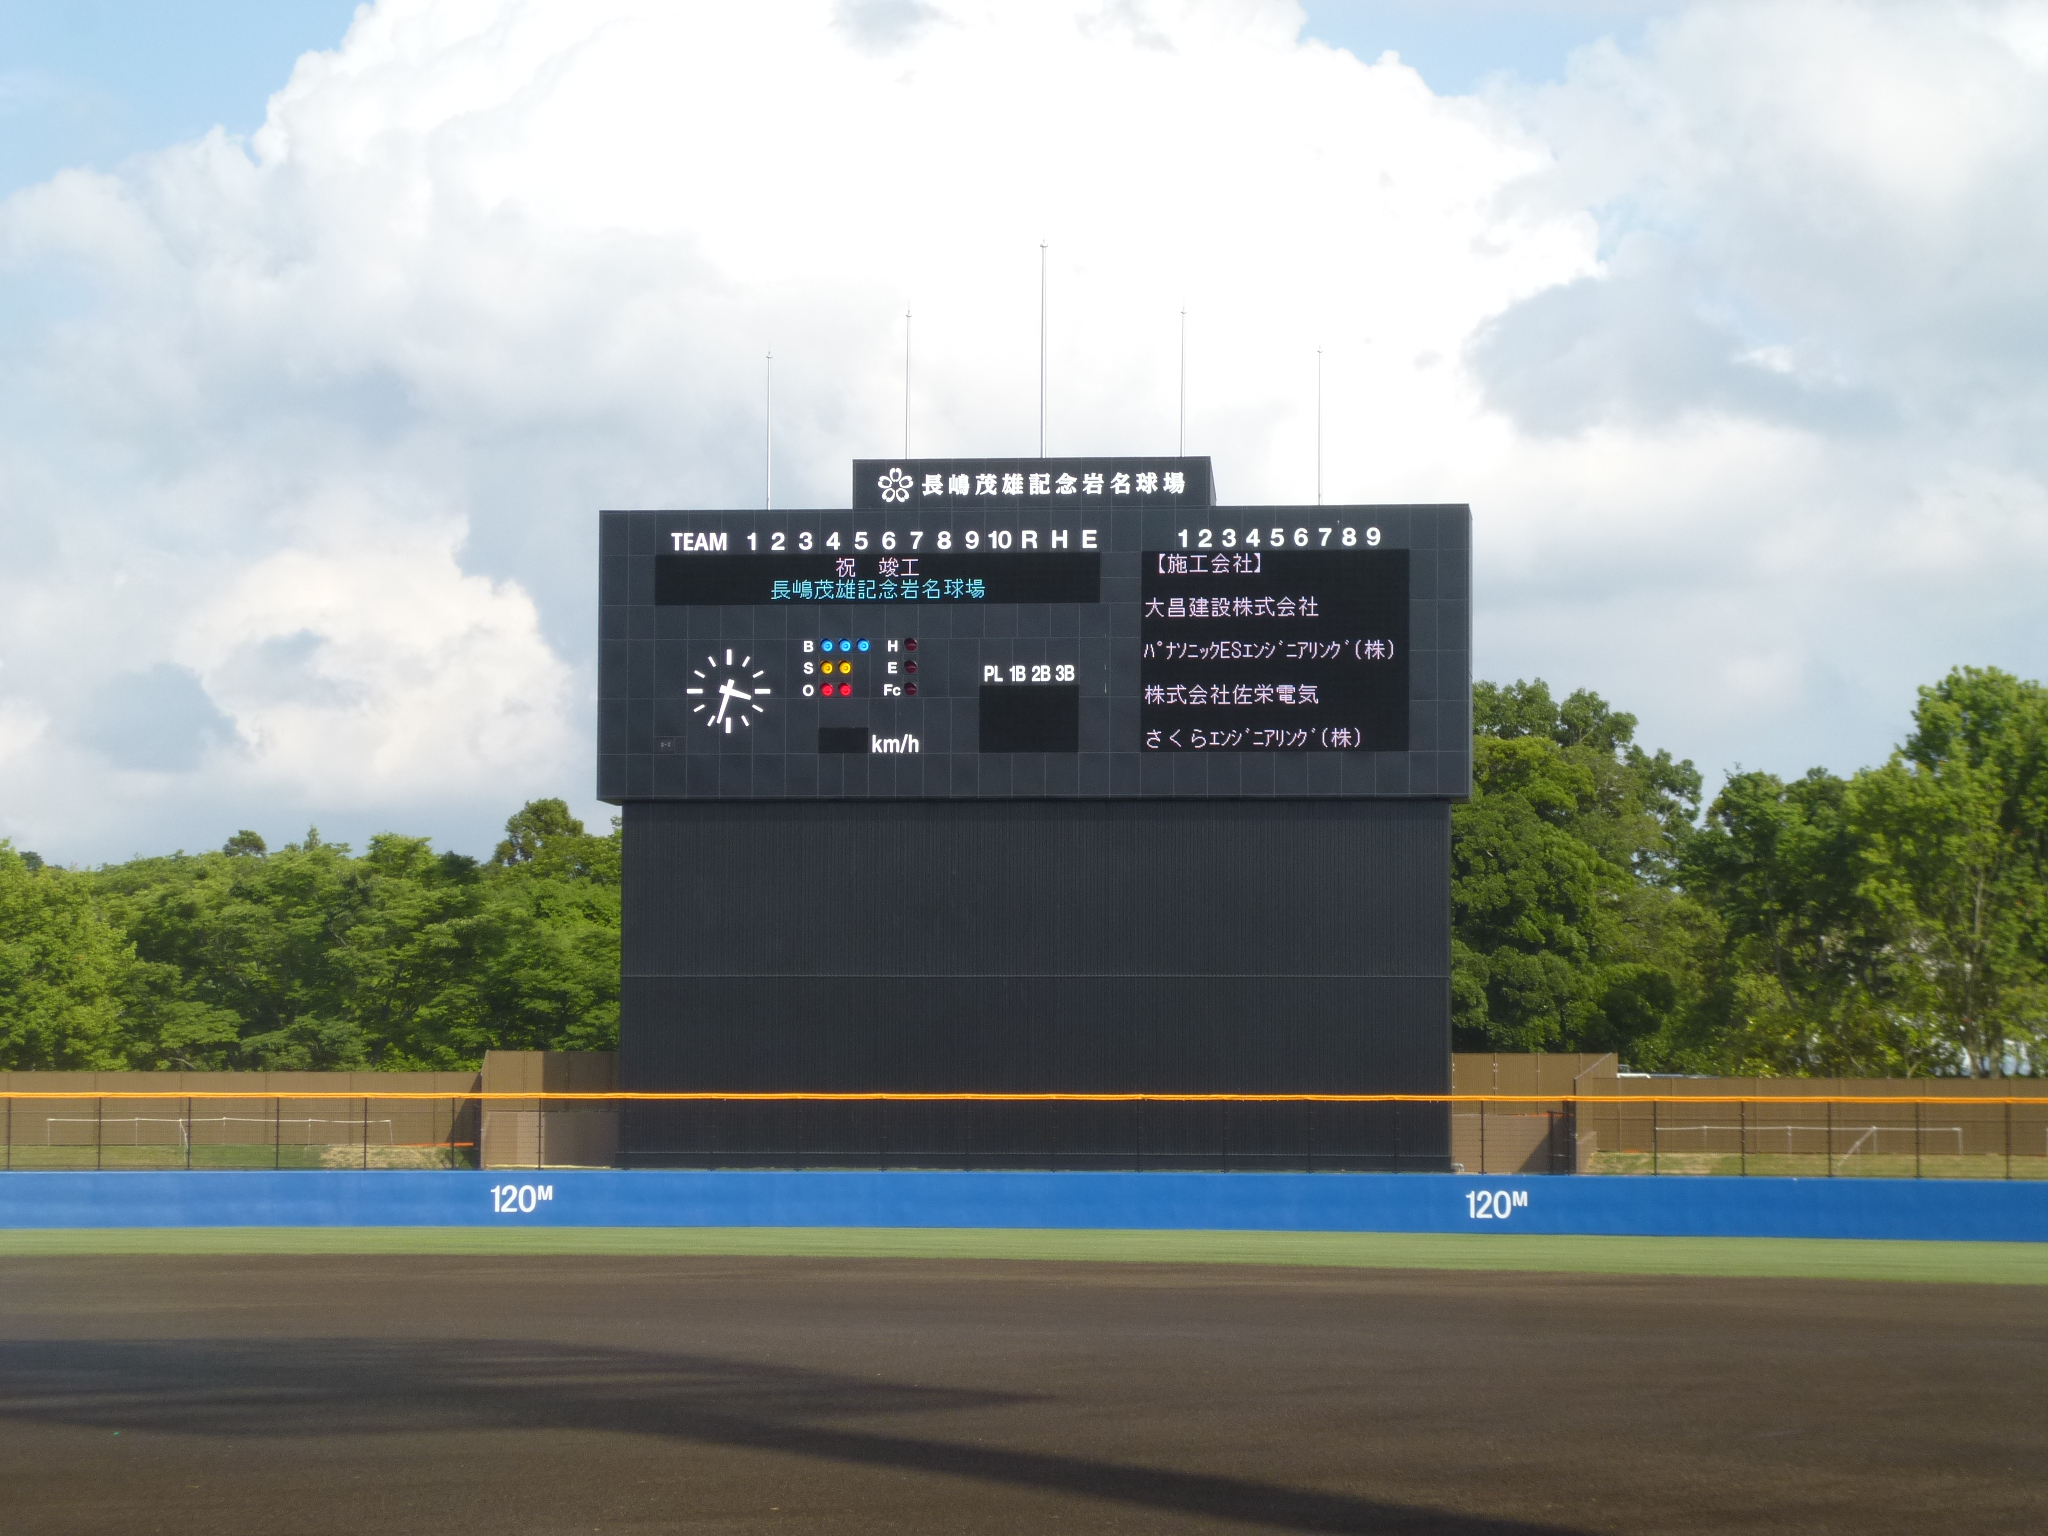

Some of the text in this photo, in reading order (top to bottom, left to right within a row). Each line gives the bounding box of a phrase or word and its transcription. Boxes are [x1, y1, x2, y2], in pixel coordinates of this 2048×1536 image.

[921, 471, 1186, 497] 長嶋茂雄記念岩名球場
[670, 529, 1098, 552] TEAM 1 2 3 4 5 6 7 8 9 10 R H E
[1177, 526, 1381, 548] 1 2 3 4 5 6 7 8 9
[835, 556, 920, 578] 祝 竣工
[1158, 552, 1261, 574] 【施工会社】
[770, 578, 986, 600] 長嶋茂雄記念岩名球場
[1145, 595, 1319, 618] 大昌建設株式会社
[803, 640, 814, 653] B
[887, 639, 899, 653] H
[803, 661, 814, 675] S
[887, 661, 898, 674] E
[983, 664, 1075, 683] PL 1B 2B 3B
[802, 684, 815, 697] O
[883, 683, 902, 697] Fc
[1144, 683, 1319, 705] 株式会社佐栄電気
[871, 733, 920, 754] km/h
[490, 1184, 553, 1213] 120M
[1465, 1190, 1528, 1219] 120M
